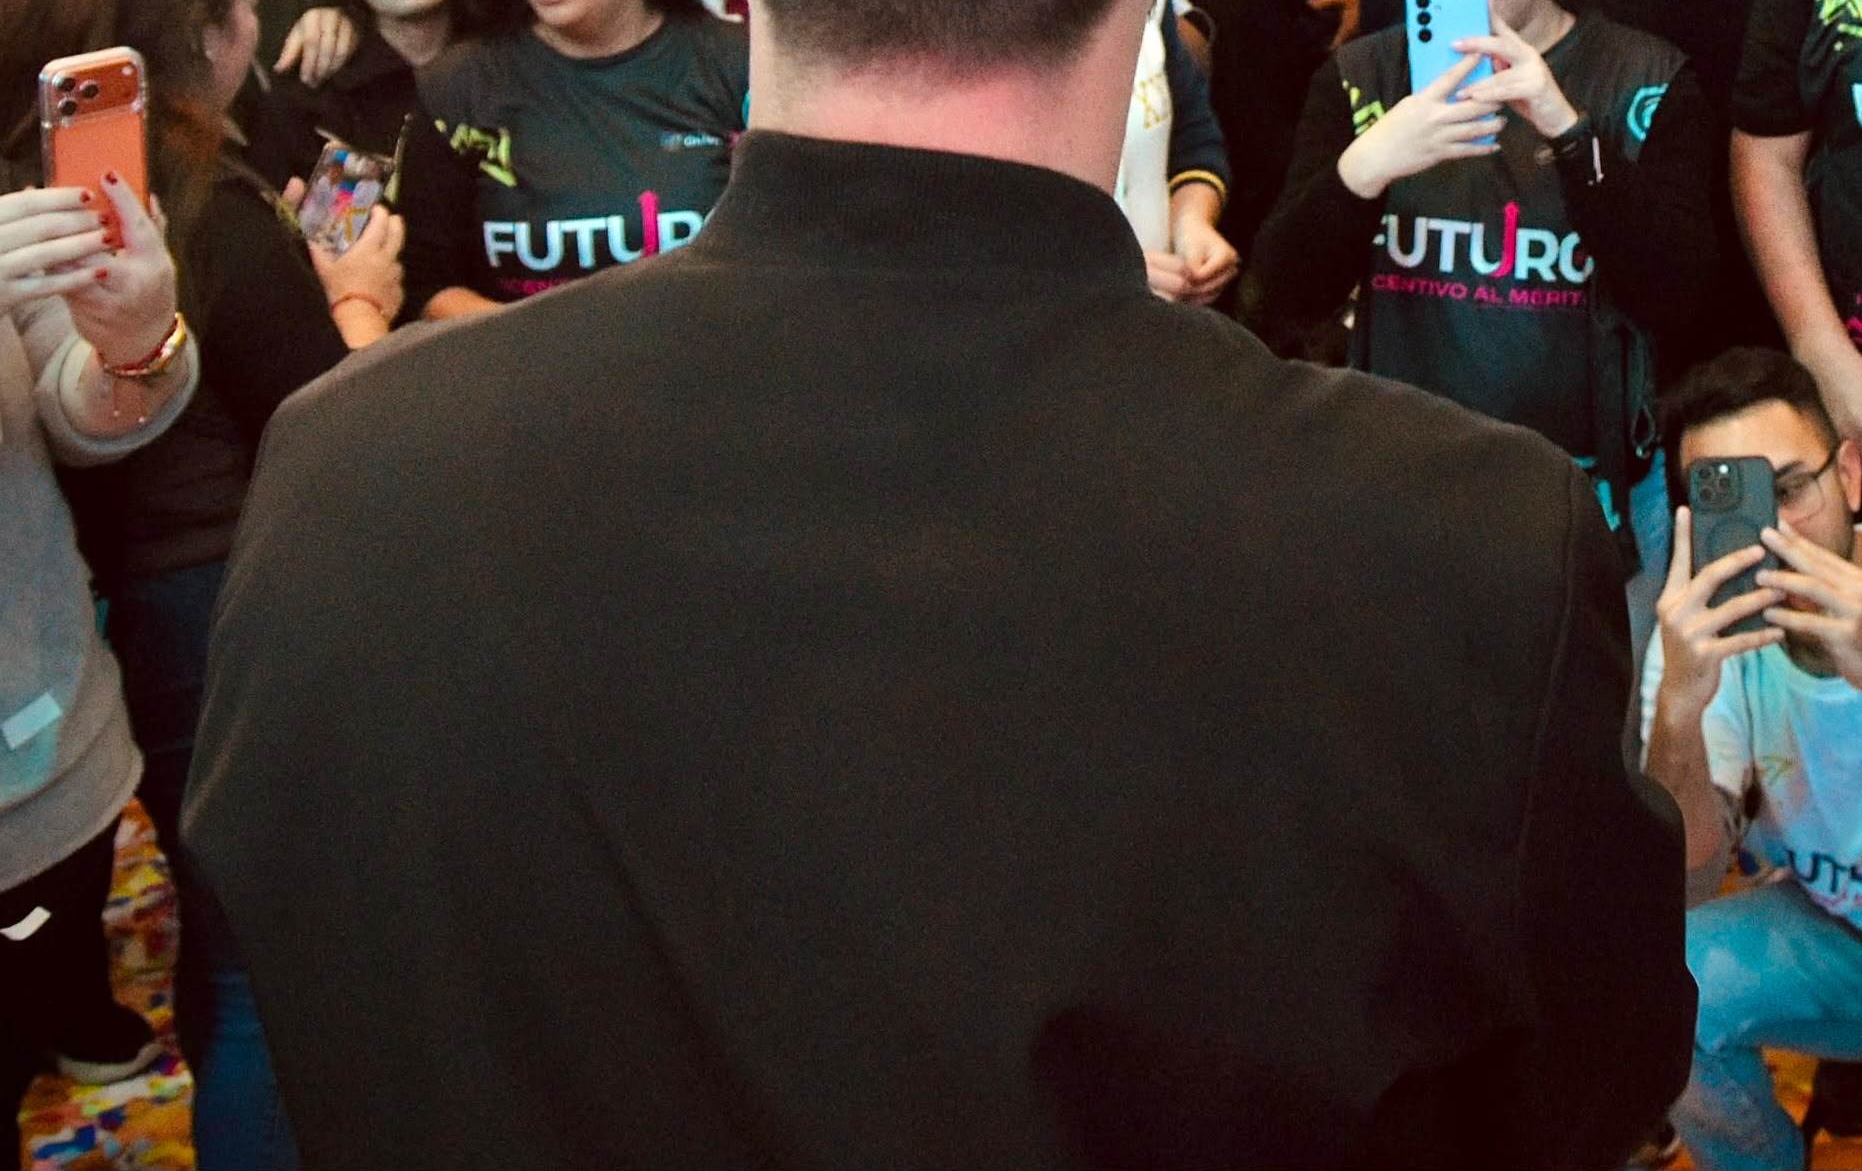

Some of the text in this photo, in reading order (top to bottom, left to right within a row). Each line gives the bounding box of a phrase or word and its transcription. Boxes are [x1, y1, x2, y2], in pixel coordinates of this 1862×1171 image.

[483, 191, 707, 271] FUTUR
[1372, 272, 1585, 307] CENTIVO AL MÉRIT
